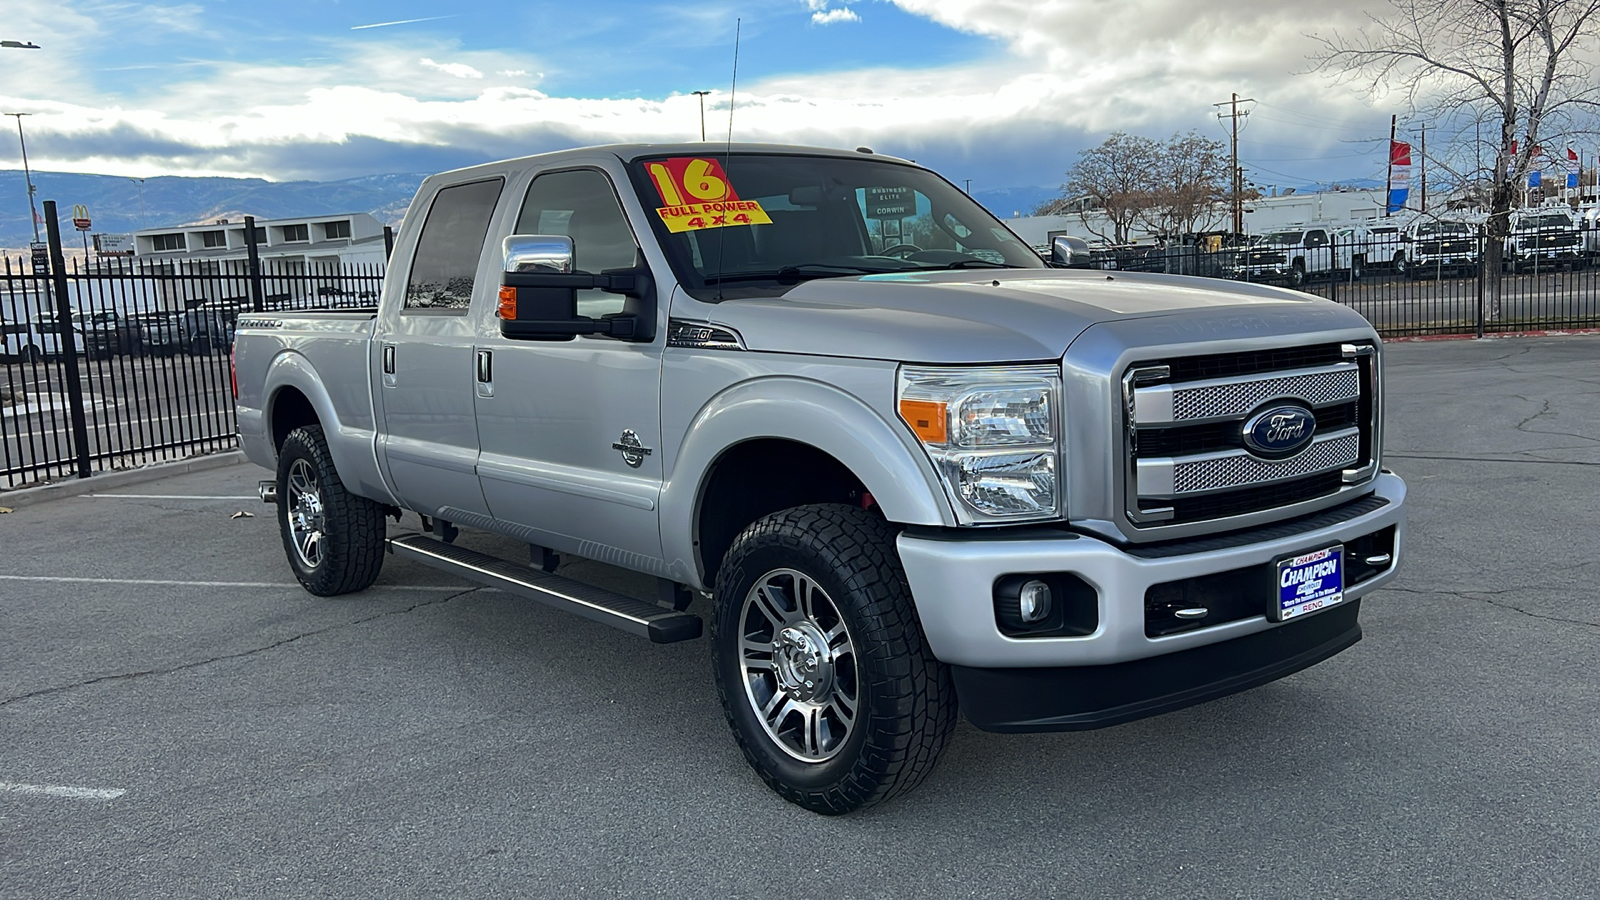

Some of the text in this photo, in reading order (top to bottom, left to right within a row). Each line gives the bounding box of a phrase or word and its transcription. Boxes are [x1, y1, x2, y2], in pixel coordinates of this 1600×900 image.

[650, 158, 731, 206] 16
[659, 201, 758, 219] FULL POWER
[876, 206, 905, 215] CORWIN
[1266, 413, 1305, 443] Ford
[1295, 551, 1326, 566] CHAMPION
[1280, 559, 1337, 588] CHAMPION
[1302, 600, 1324, 613] RENO
